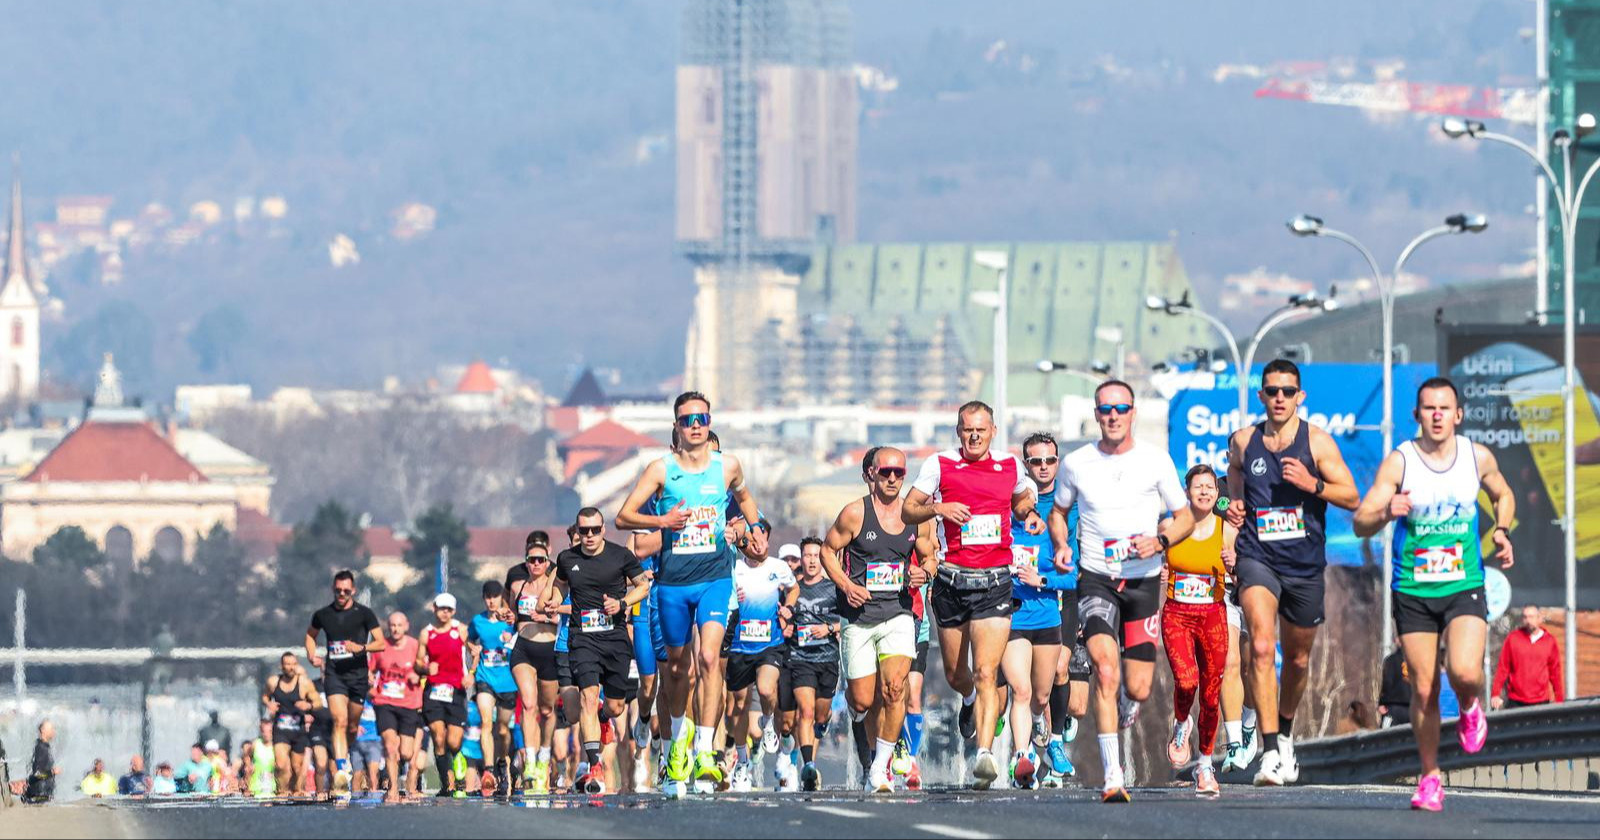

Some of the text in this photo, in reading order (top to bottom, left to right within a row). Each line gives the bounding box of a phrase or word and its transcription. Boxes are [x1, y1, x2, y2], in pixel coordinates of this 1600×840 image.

[1462, 353, 1514, 375] Učini
[1463, 402, 1553, 426] koji raste
[1464, 424, 1560, 448] mogućim
